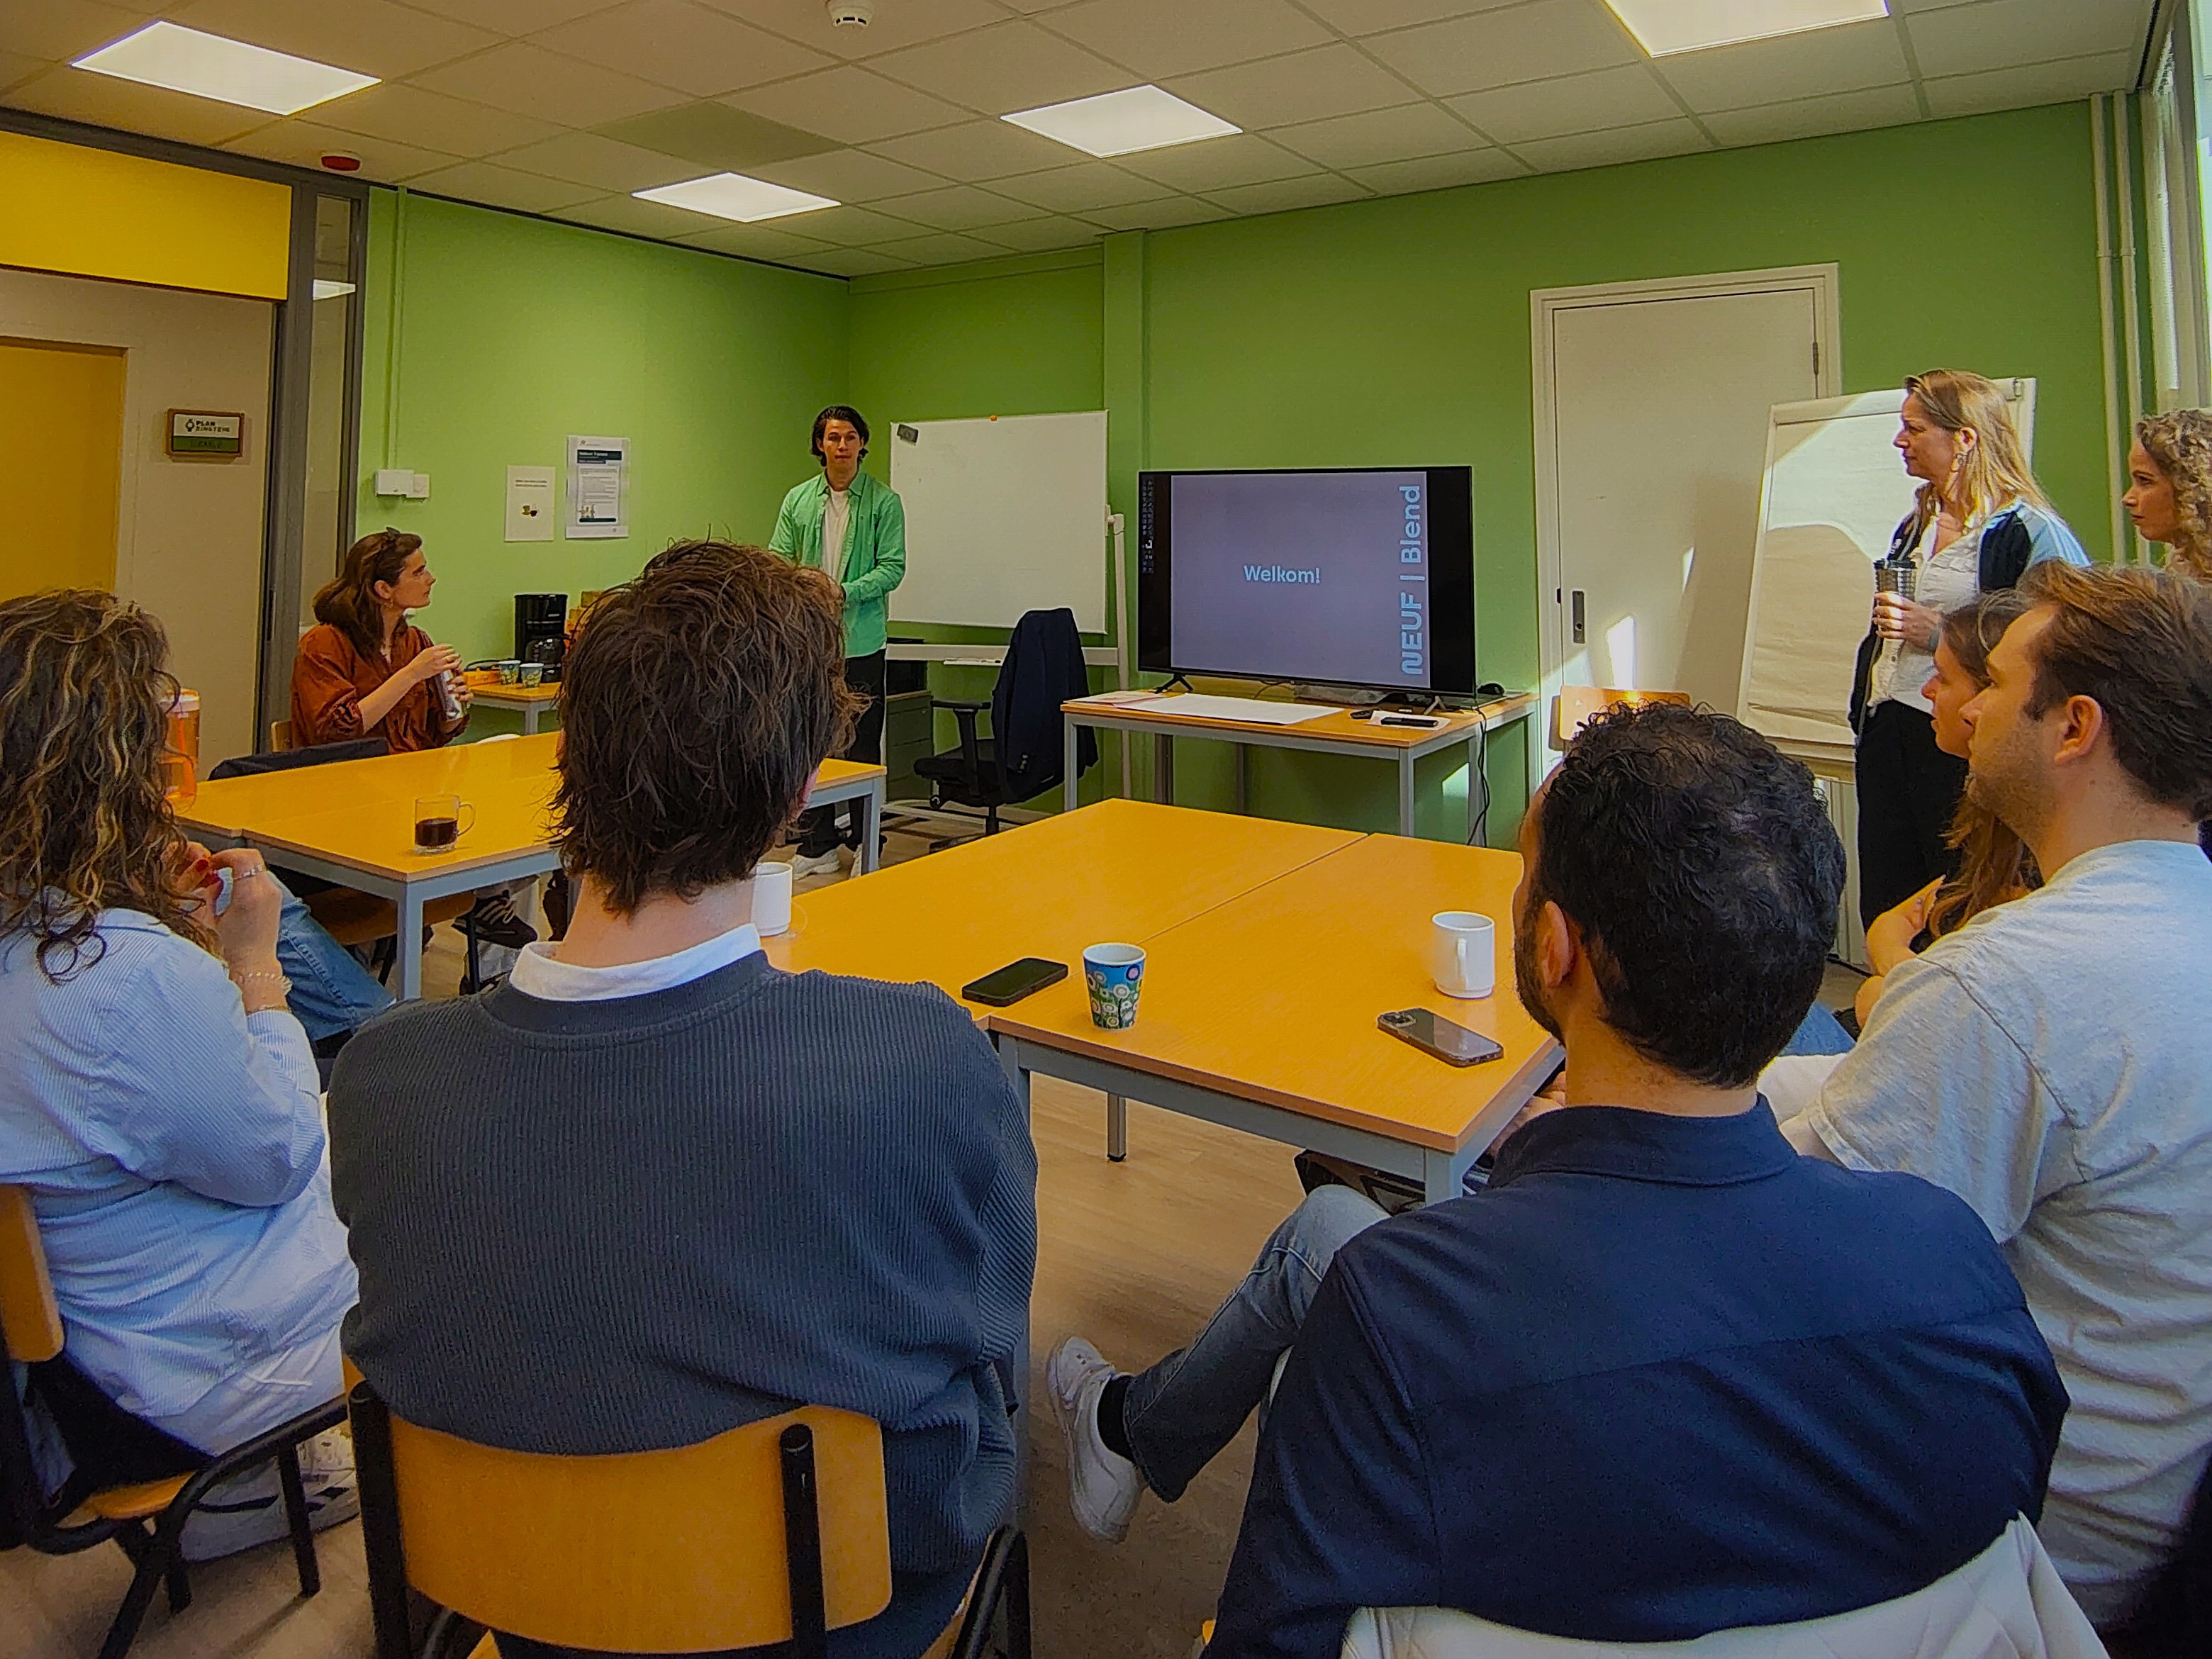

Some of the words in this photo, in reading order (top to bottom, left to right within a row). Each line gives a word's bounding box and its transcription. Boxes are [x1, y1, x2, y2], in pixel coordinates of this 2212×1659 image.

[1400, 485, 1421, 563] Blend
[1243, 565, 1319, 583] Welkom!
[1401, 591, 1423, 675] NEUF
